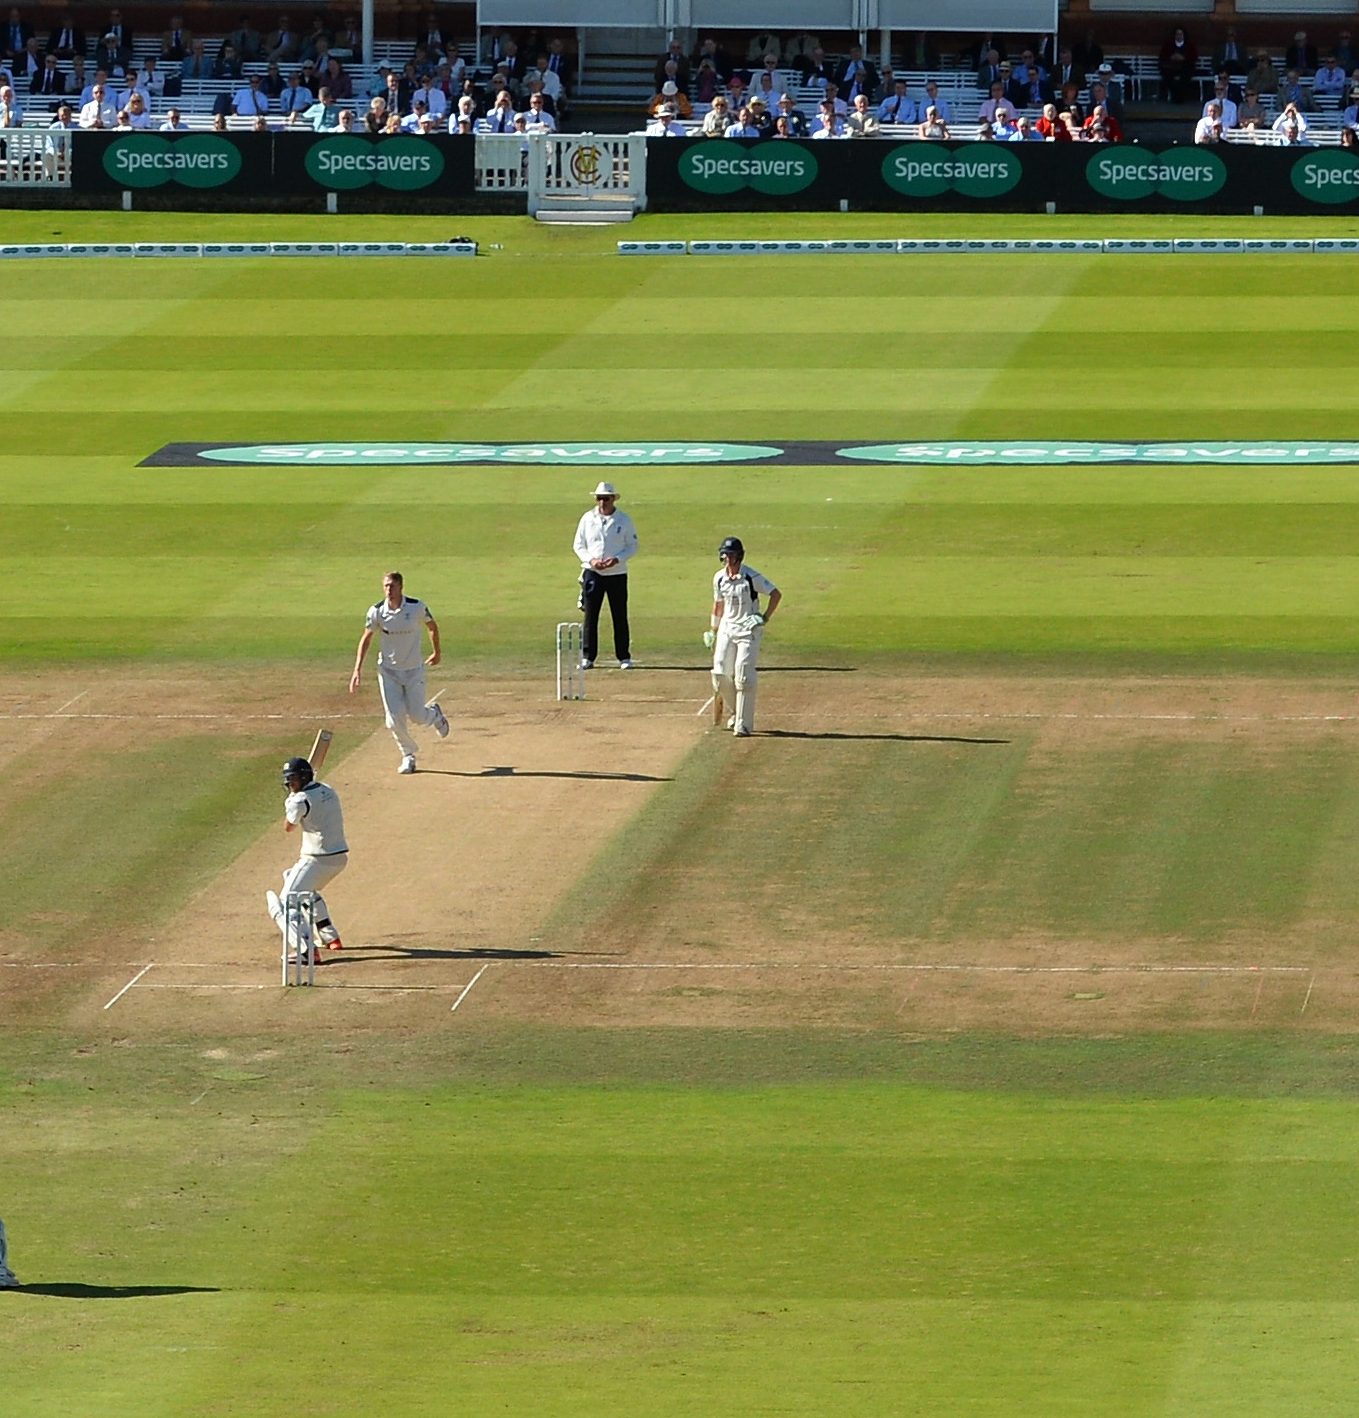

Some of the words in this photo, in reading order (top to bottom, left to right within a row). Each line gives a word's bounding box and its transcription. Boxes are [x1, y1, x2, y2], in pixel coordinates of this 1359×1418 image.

[116, 148, 228, 173] Specsavers
[318, 149, 431, 174] Specsavers
[691, 154, 805, 179] Specsavers
[894, 156, 1009, 181] Specsavers
[1099, 159, 1214, 184] Specsavers
[255, 446, 725, 459] Specsavers
